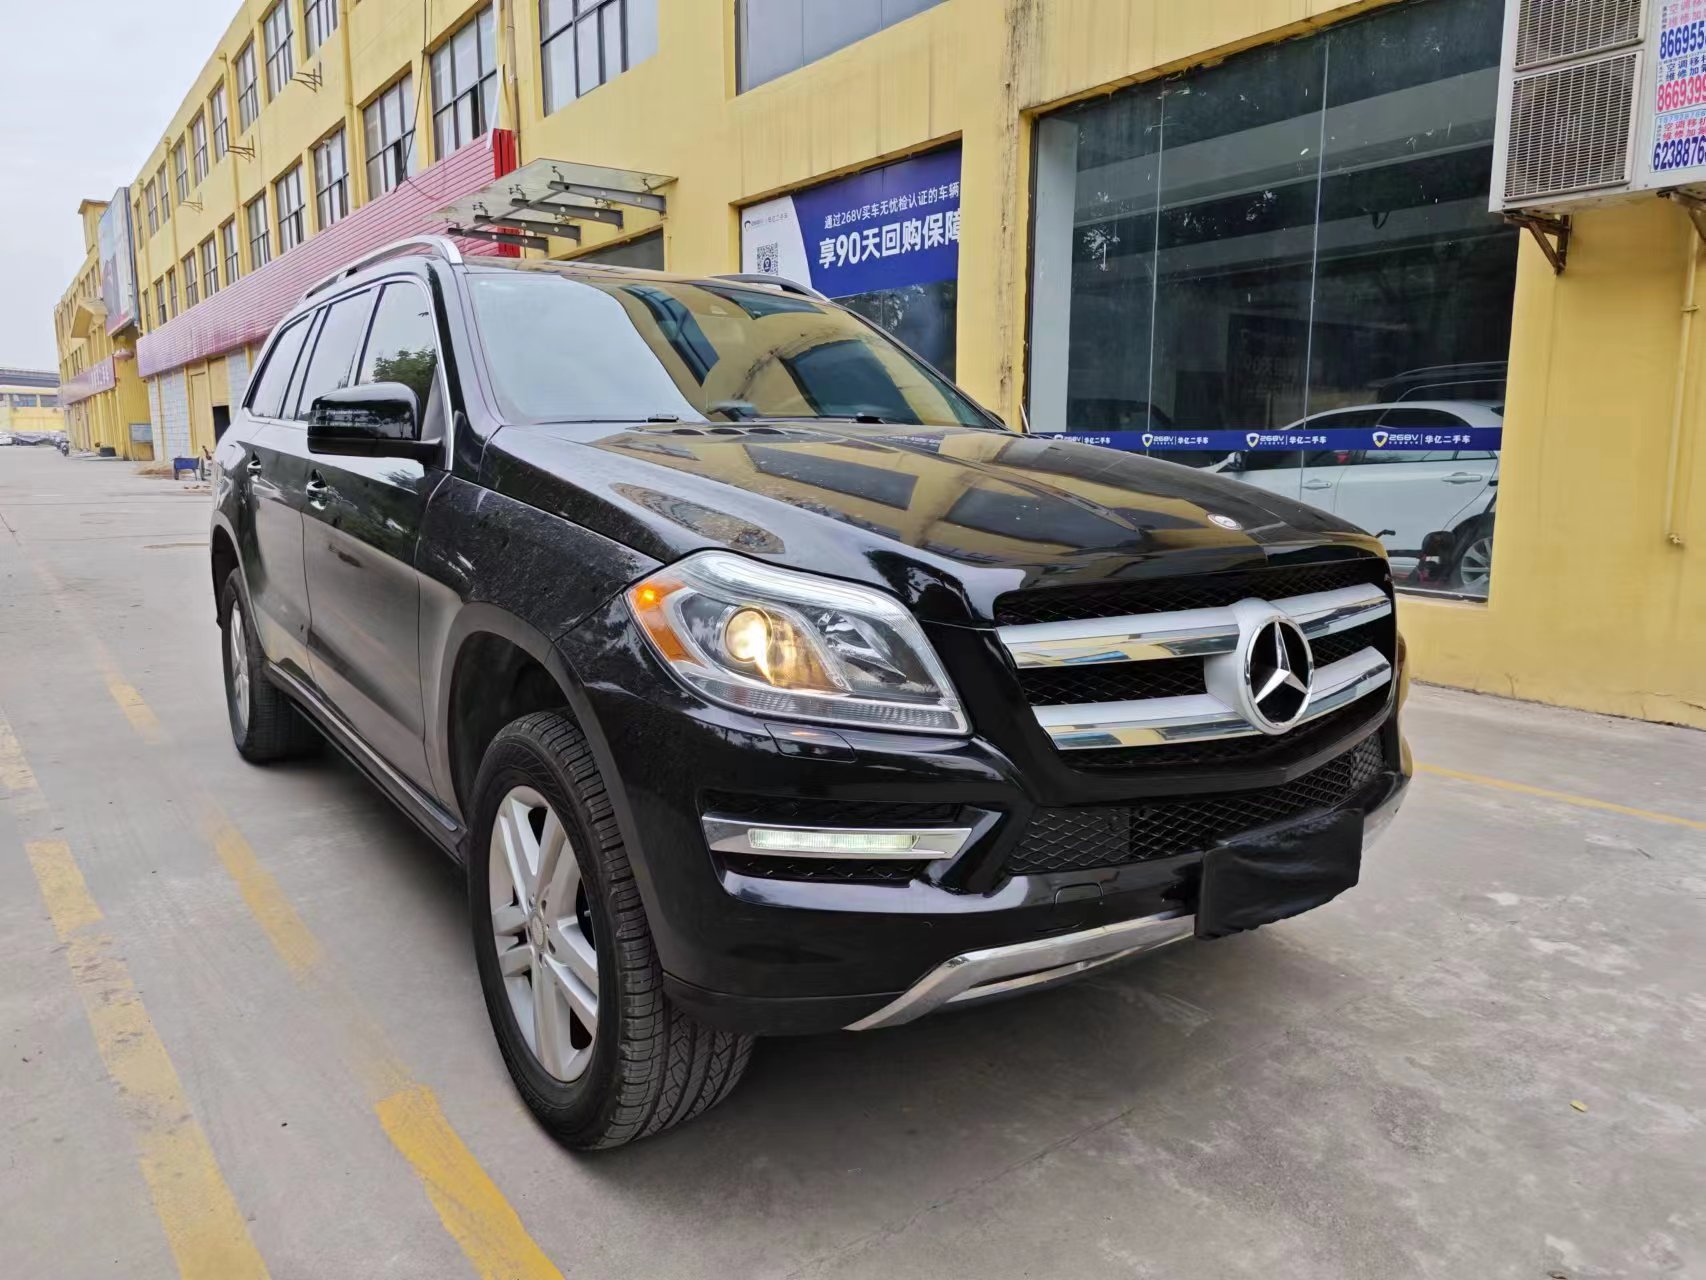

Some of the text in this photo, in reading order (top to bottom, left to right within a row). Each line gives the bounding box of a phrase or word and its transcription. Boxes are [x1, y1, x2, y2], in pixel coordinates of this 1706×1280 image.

[1660, 21, 1706, 59] 866955
[1653, 135, 1706, 171] 6238876
[824, 181, 959, 229] 通过268V买车无忧检认证的车辆
[819, 208, 960, 269] 享90天回购保障
[1289, 436, 1327, 444] 华亿二手车
[1425, 434, 1471, 444] 华亿二手车
